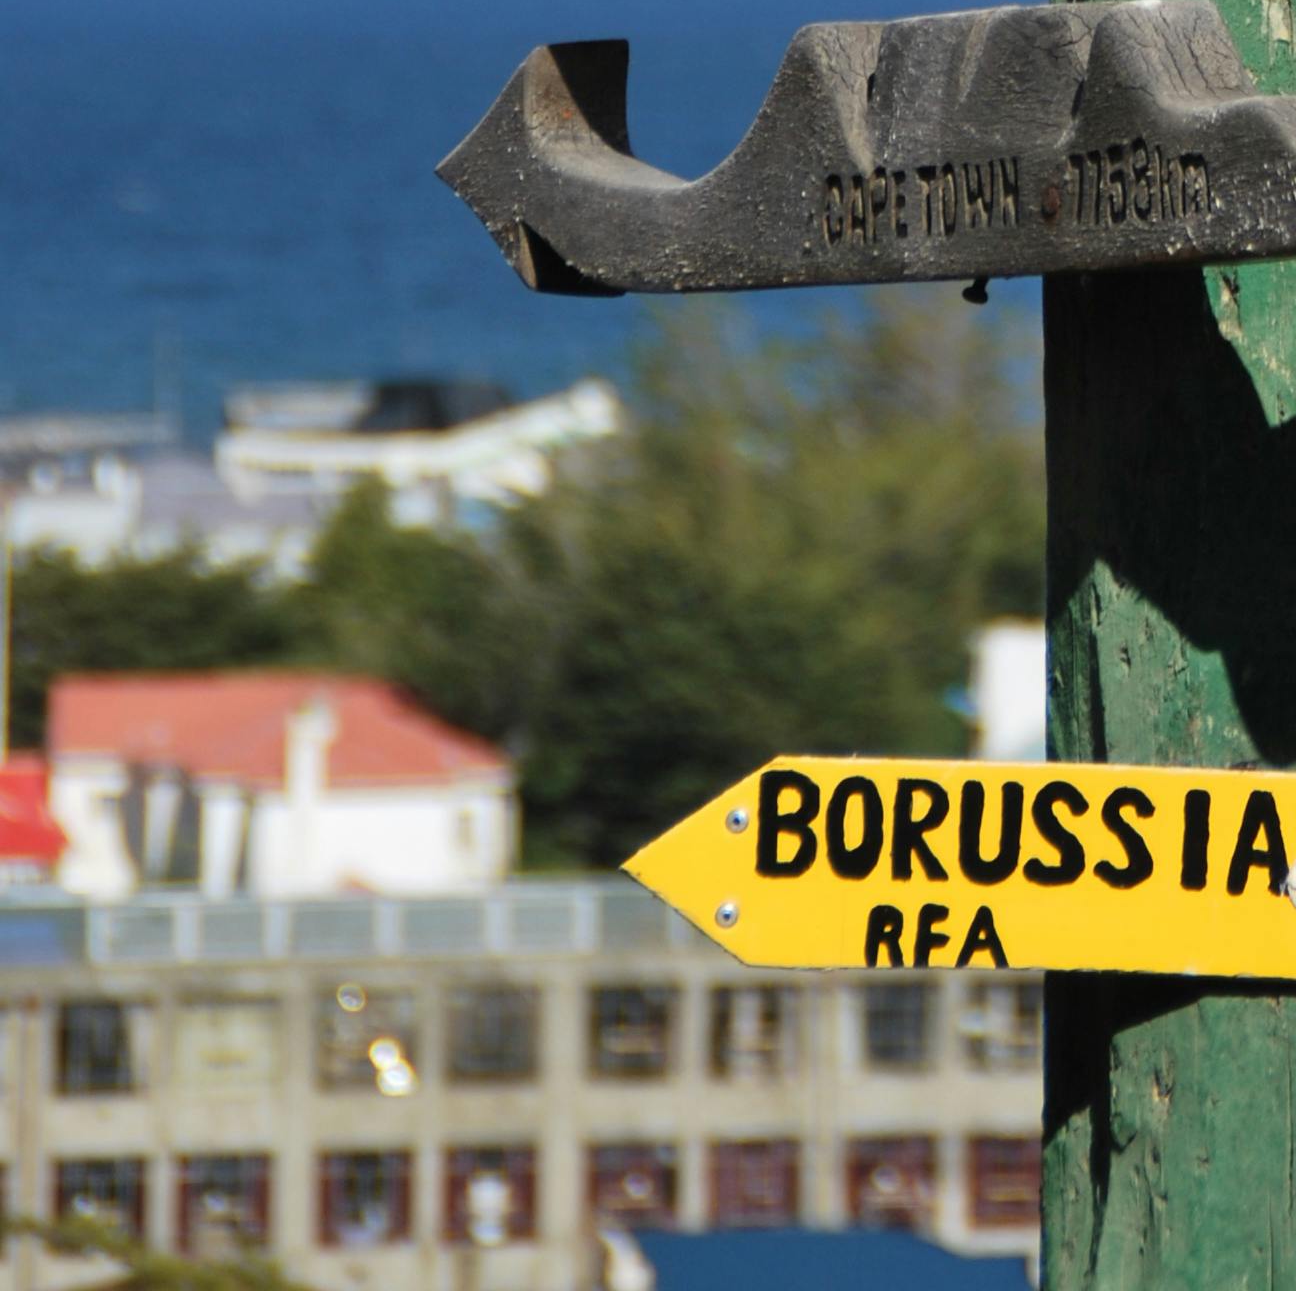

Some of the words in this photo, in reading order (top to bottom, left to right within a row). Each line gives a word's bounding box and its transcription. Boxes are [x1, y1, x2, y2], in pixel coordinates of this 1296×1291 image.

[823, 165, 908, 247] CAPE
[916, 156, 1019, 237] TOWN
[755, 769, 1290, 896] BORUSSIA
[865, 903, 1008, 968] RFA
